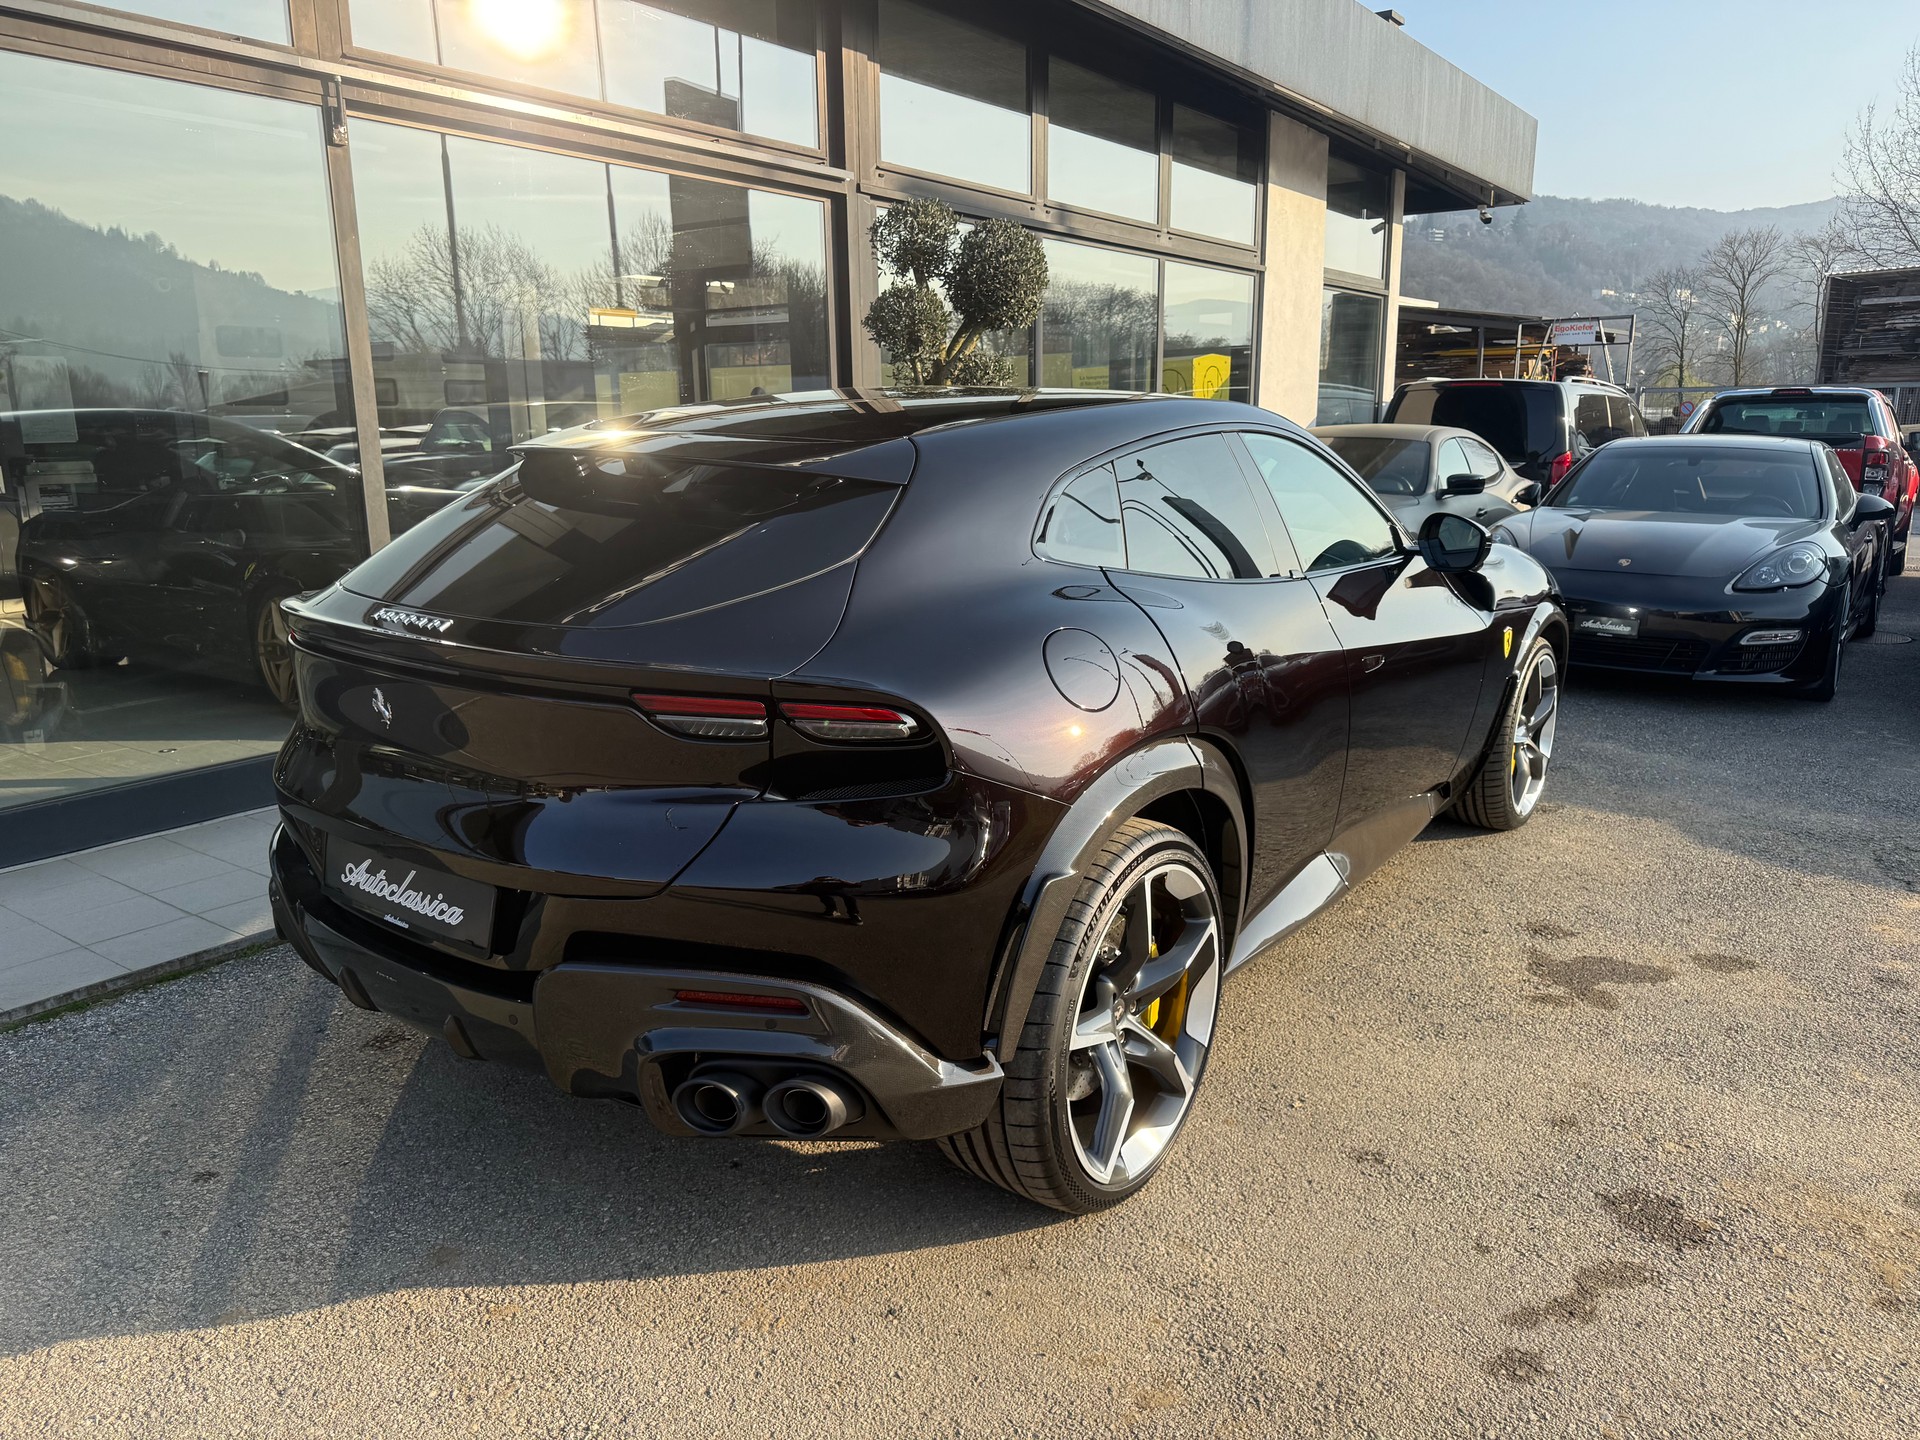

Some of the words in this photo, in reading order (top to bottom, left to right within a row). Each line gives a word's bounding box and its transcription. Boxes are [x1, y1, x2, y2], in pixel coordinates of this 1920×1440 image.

[1554, 323, 1594, 333] EgoKiefer
[1580, 619, 1632, 632] Autoclassica
[341, 858, 465, 926] Autoclassica
[1077, 885, 1115, 959] MICHELIN
